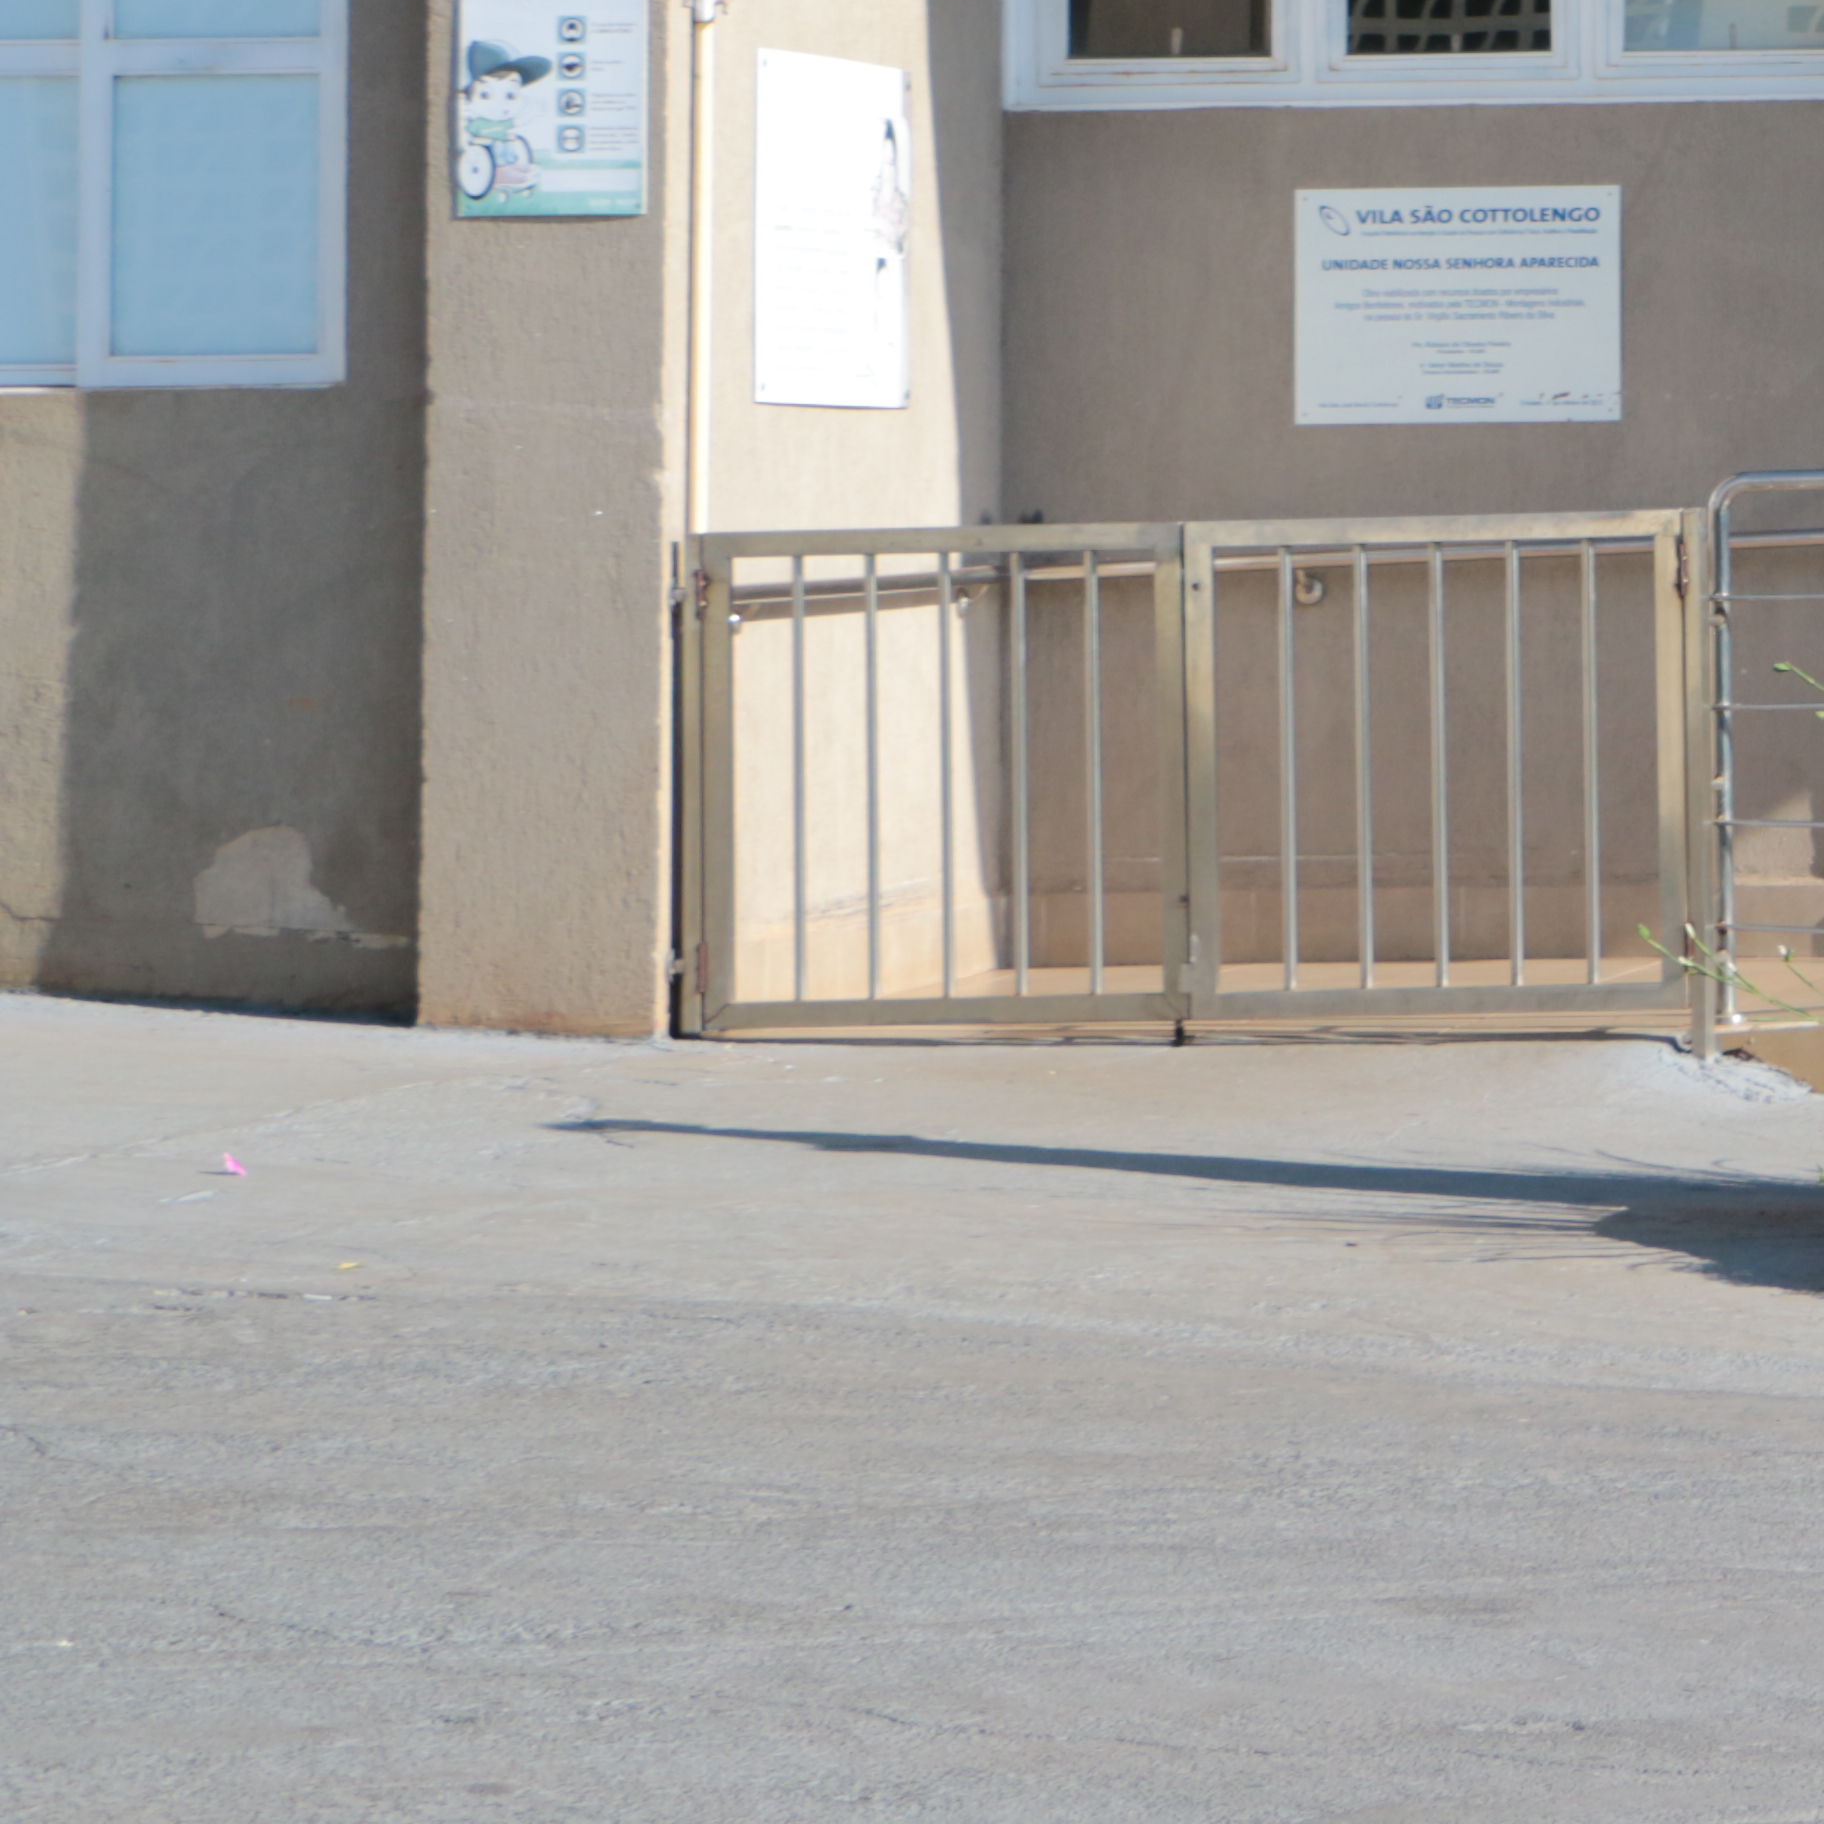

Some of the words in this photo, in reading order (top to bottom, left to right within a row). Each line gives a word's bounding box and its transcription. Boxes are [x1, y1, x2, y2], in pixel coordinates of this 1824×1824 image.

[1356, 210, 1403, 225] VILA
[1410, 206, 1453, 224] SÃO
[1459, 207, 1601, 223] COTTOLENGO
[1321, 258, 1389, 271] UNIDADE
[1392, 258, 1441, 270] NOSSA
[1445, 257, 1515, 269] SENHORA
[1519, 256, 1600, 268] APARECIDA
